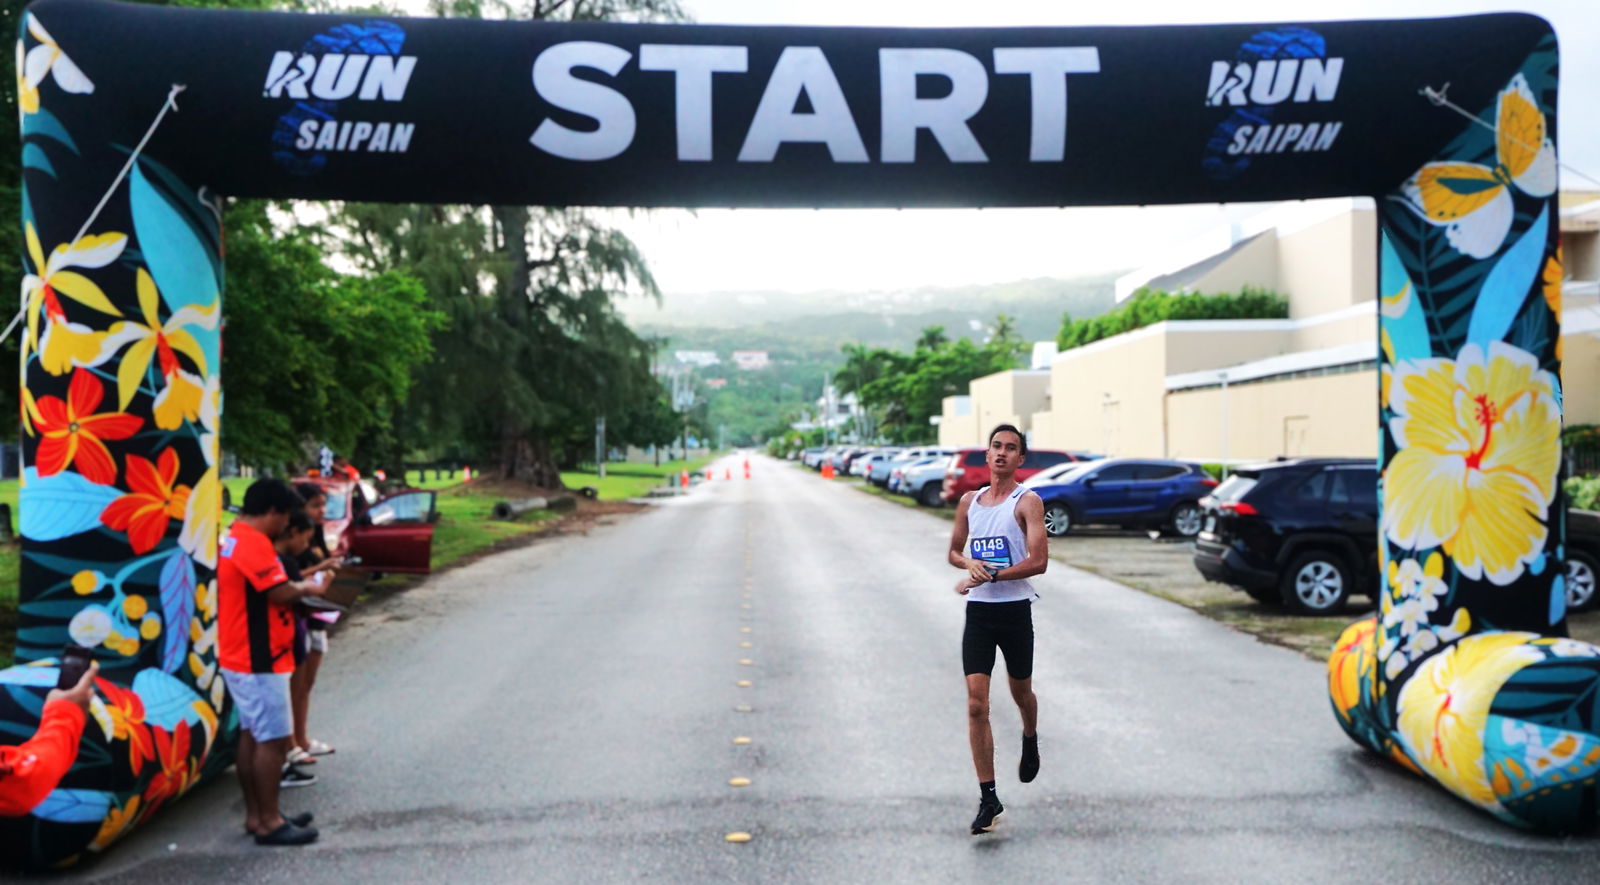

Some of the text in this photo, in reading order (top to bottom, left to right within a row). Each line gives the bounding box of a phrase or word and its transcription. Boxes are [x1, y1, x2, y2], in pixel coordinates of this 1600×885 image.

[263, 50, 418, 101] RUN
[1205, 57, 1344, 105] RUN
[530, 41, 1101, 163] START
[296, 119, 415, 152] SAIPAN
[1227, 121, 1343, 155] SAIPAN
[974, 538, 1004, 552] 0148
